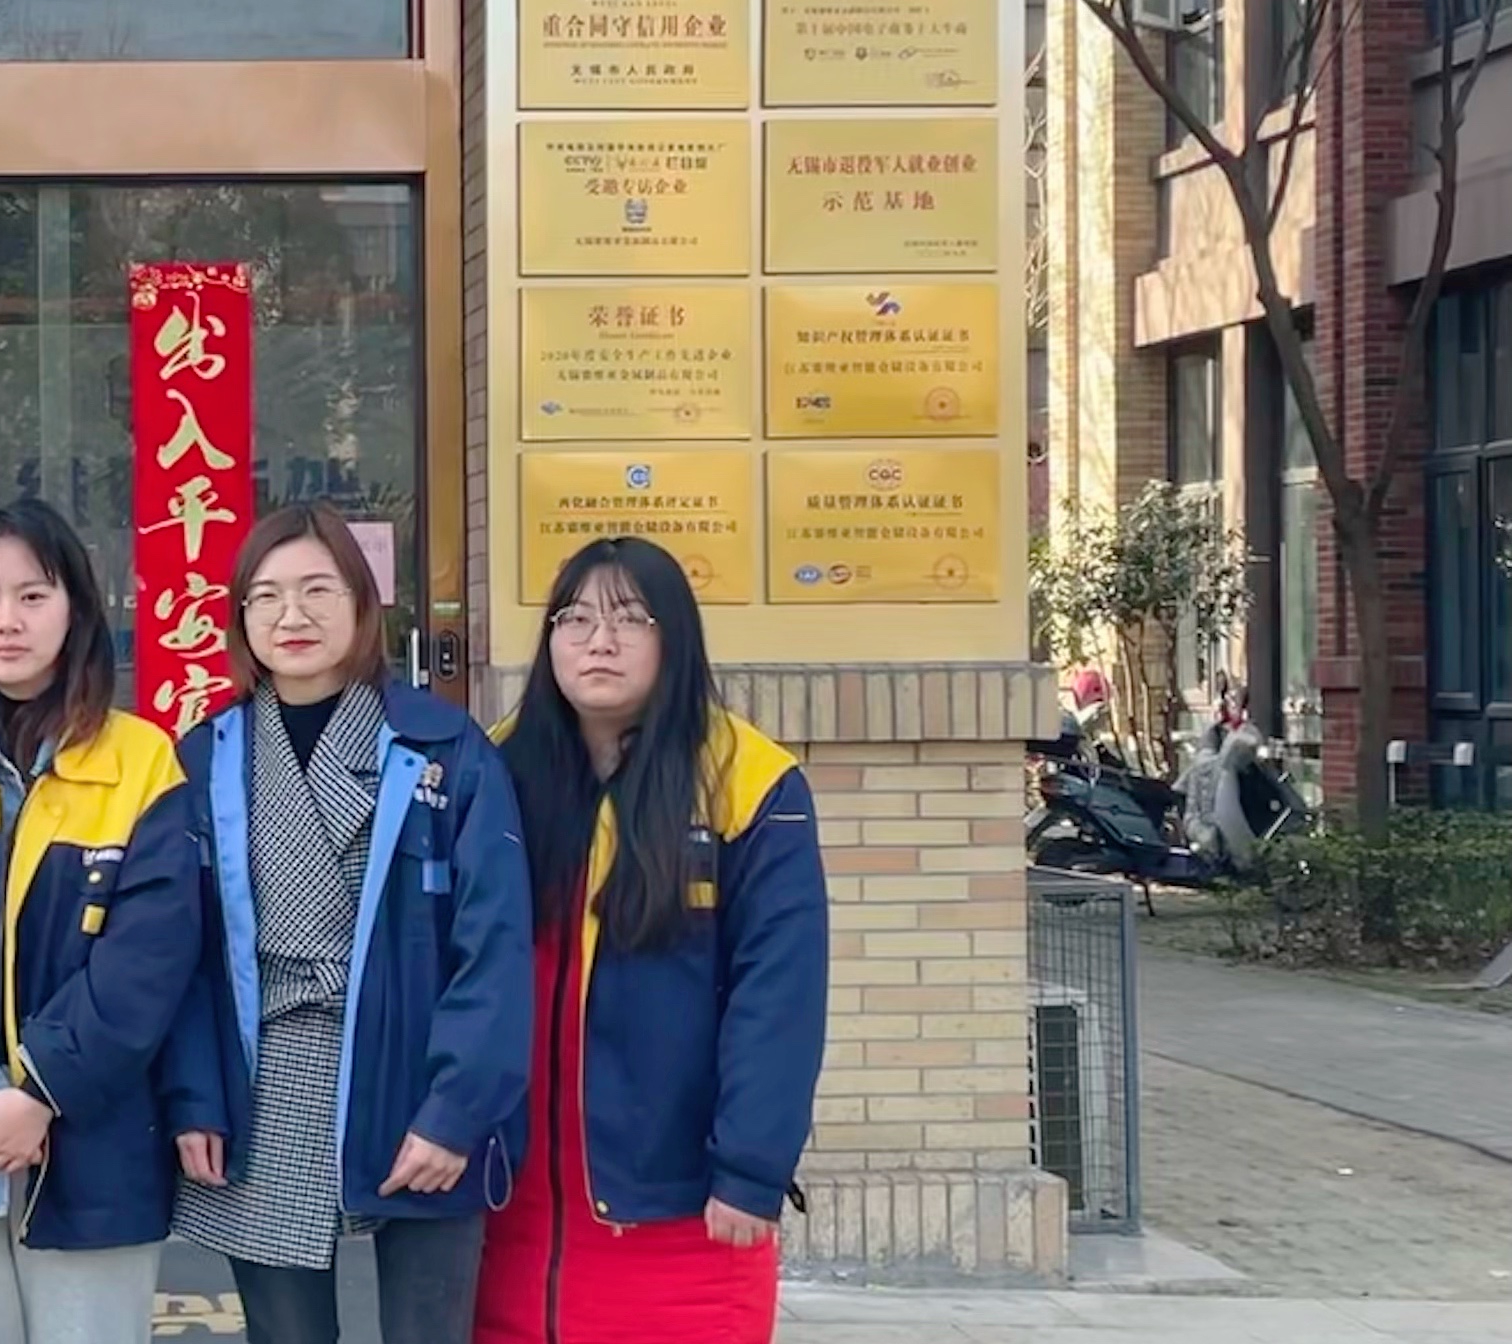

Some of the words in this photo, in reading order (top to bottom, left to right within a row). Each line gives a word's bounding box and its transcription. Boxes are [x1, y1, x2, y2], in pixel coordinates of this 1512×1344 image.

[543, 13, 727, 38] 重合同守信用企业
[787, 154, 978, 175] 无锡市退役军人就业创业
[822, 189, 936, 212] 示范基地
[588, 304, 688, 328] 荣誉证书
